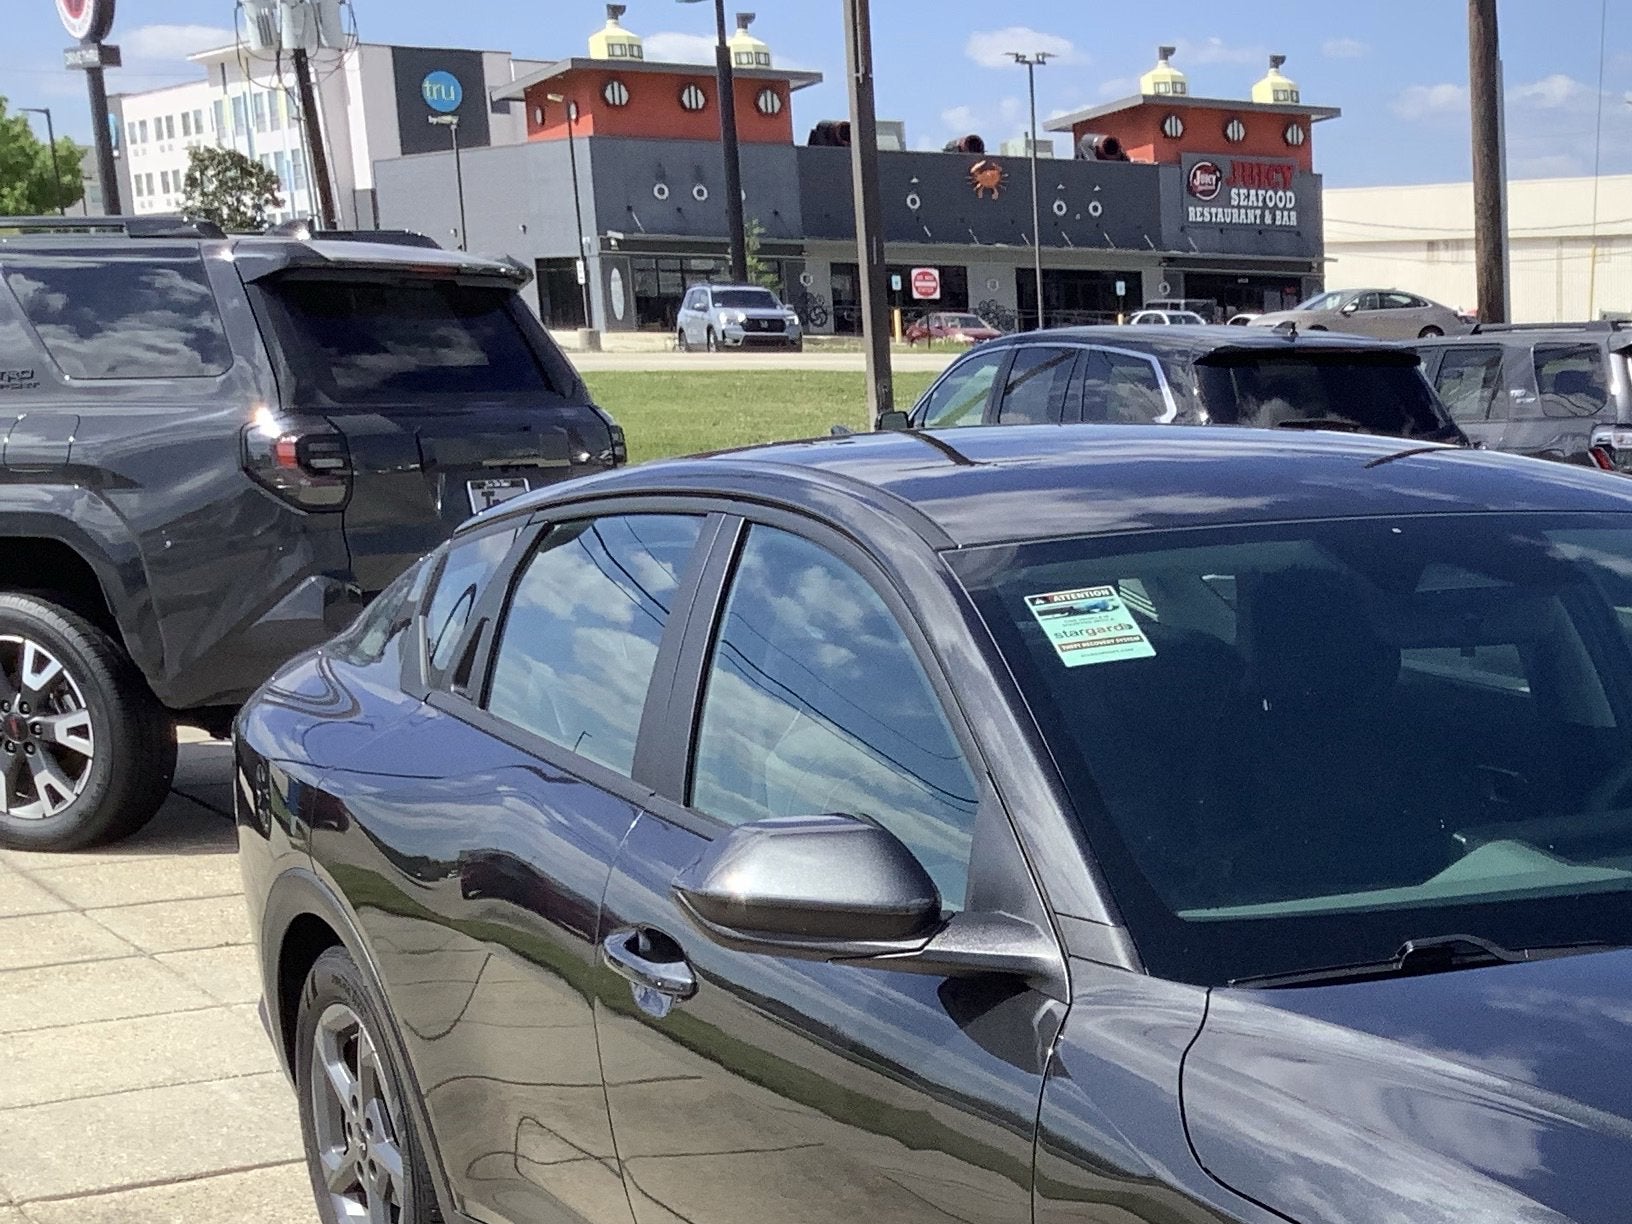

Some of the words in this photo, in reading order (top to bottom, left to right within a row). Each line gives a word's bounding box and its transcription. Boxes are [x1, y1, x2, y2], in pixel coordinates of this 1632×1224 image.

[423, 81, 455, 101] tru
[1225, 161, 1294, 190] JUICY
[1230, 188, 1296, 208] SEAFOOD
[1188, 206, 1261, 225] RESTAURANT
[1264, 210, 1272, 225] &
[1275, 210, 1298, 226] BAR
[1053, 589, 1110, 602] ATTENTION
